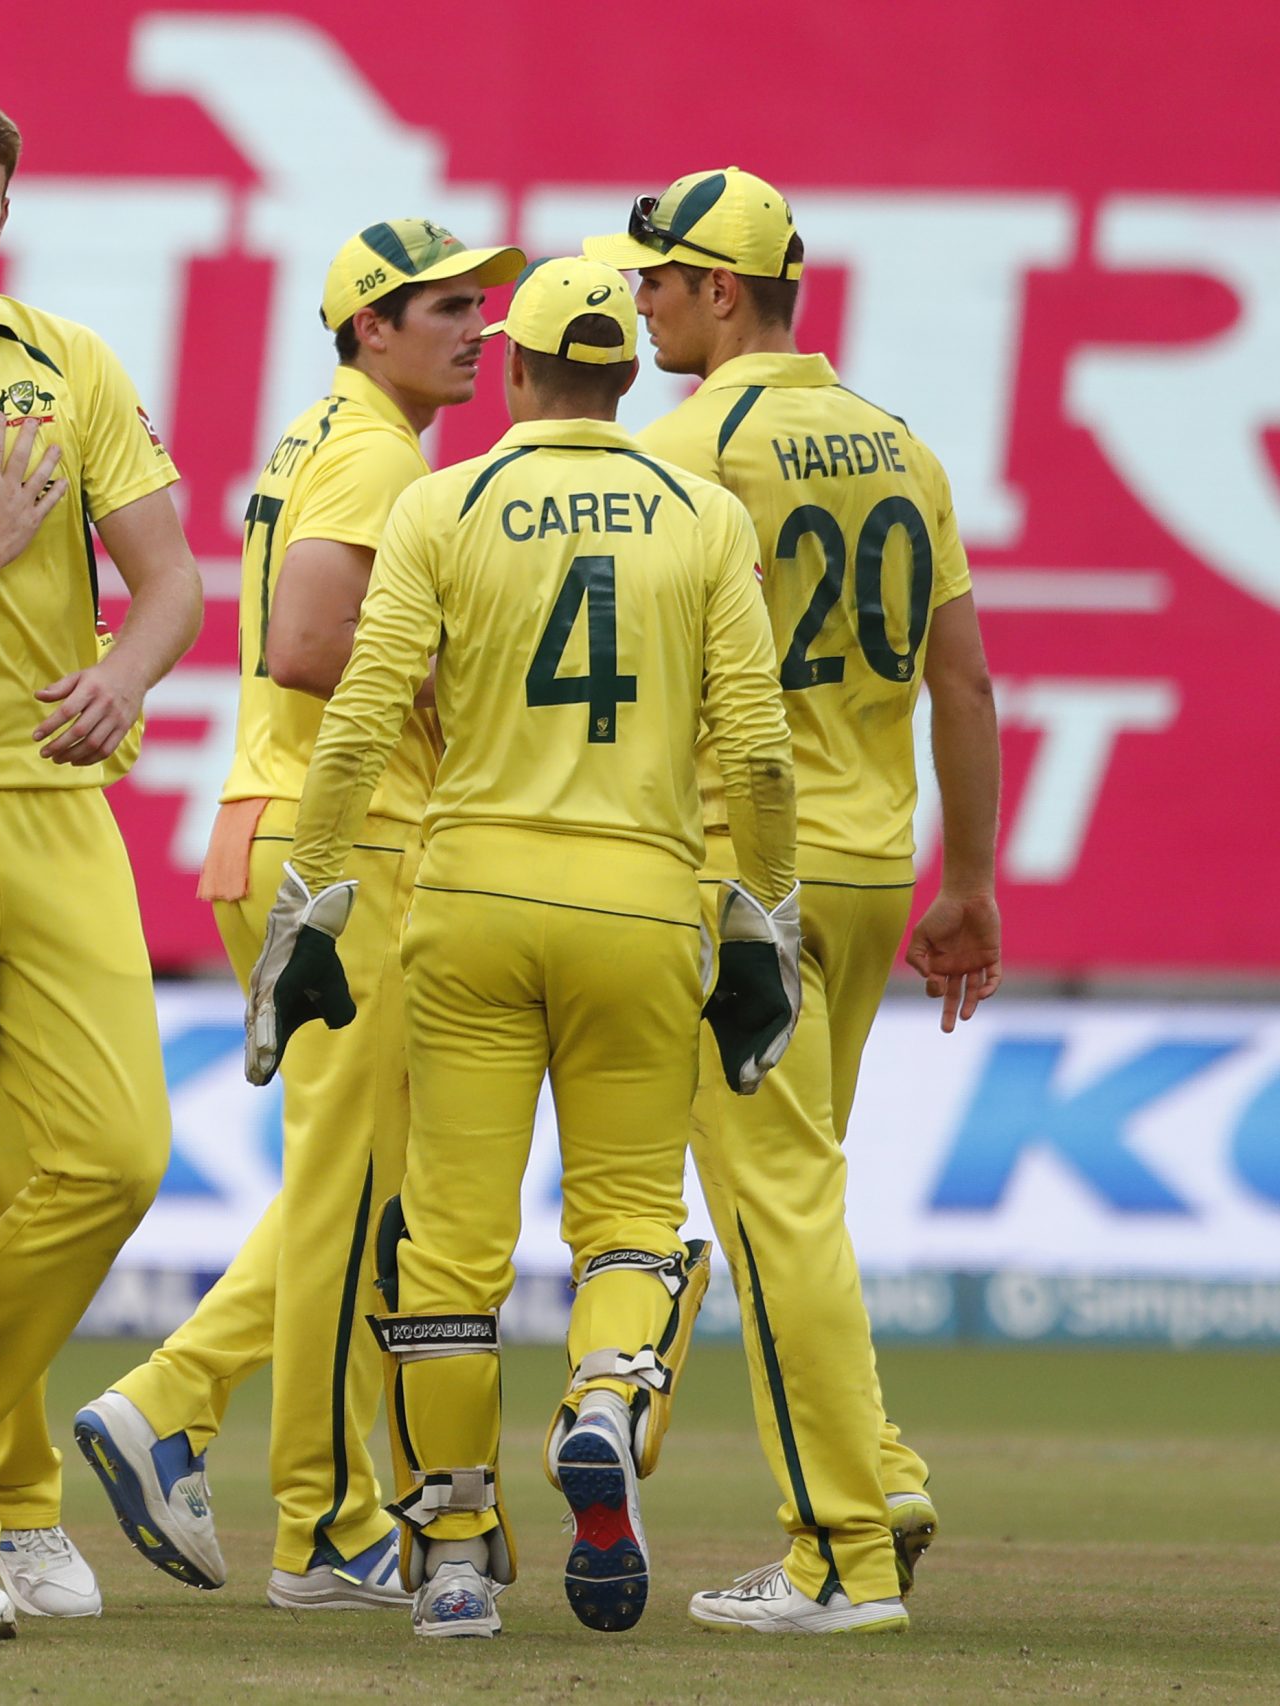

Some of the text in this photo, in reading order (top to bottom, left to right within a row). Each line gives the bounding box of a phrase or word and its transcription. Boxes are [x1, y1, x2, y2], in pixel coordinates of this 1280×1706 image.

[355, 267, 387, 295] 205
[264, 434, 309, 478] OTT
[771, 431, 907, 481] HARDIE
[501, 492, 662, 542] CAREY
[776, 495, 933, 690] 20
[525, 555, 637, 744] 4
[392, 1323, 493, 1340] KOOKABURRA
